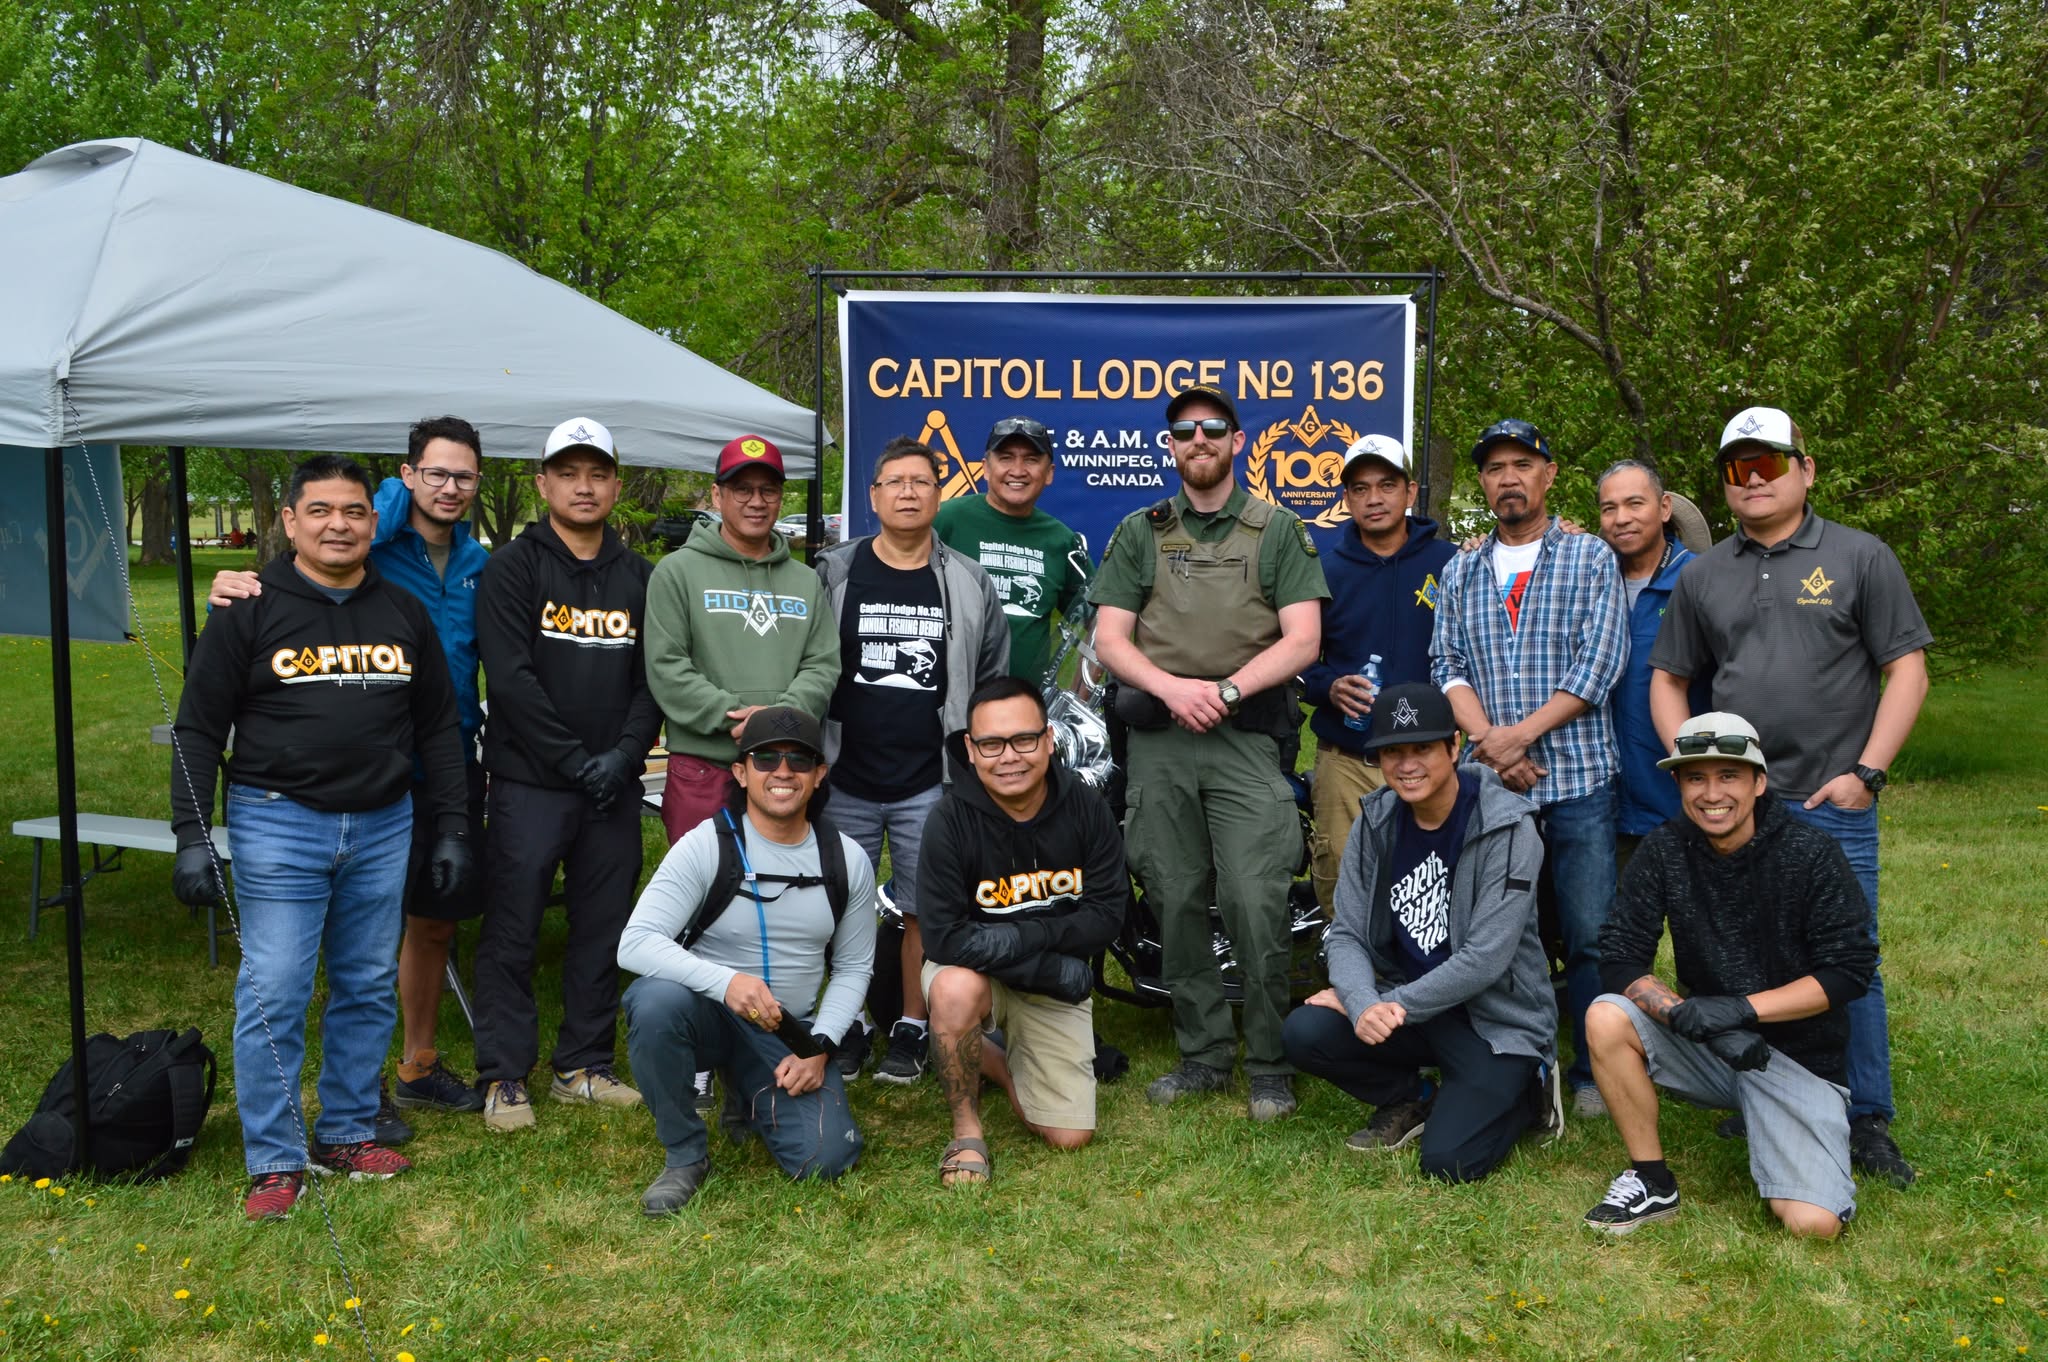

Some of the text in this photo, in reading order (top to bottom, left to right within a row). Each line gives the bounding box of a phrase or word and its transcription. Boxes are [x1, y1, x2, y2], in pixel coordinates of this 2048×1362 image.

[868, 357, 1062, 400] CAPITOL
[1072, 358, 1226, 400] LODGE
[1311, 360, 1385, 400] 136
[1065, 429, 1085, 448] &
[1090, 429, 1149, 449] A.M.
[1060, 454, 1158, 469] WINNIPEG,
[1271, 450, 1346, 488] 100
[1086, 473, 1165, 487] CANADA
[1281, 491, 1337, 499] ANNIVERSARY
[980, 541, 1004, 552] Capitol
[1005, 543, 1024, 555] Lodge
[980, 552, 1045, 575] ANNUAL FISHING DERBY
[860, 603, 890, 615] Capitol
[890, 603, 916, 617] Lodge
[858, 617, 944, 638] ANNUAL FISHING DERBY
[883, 642, 897, 661] Park
[860, 657, 896, 671] Manitoba
